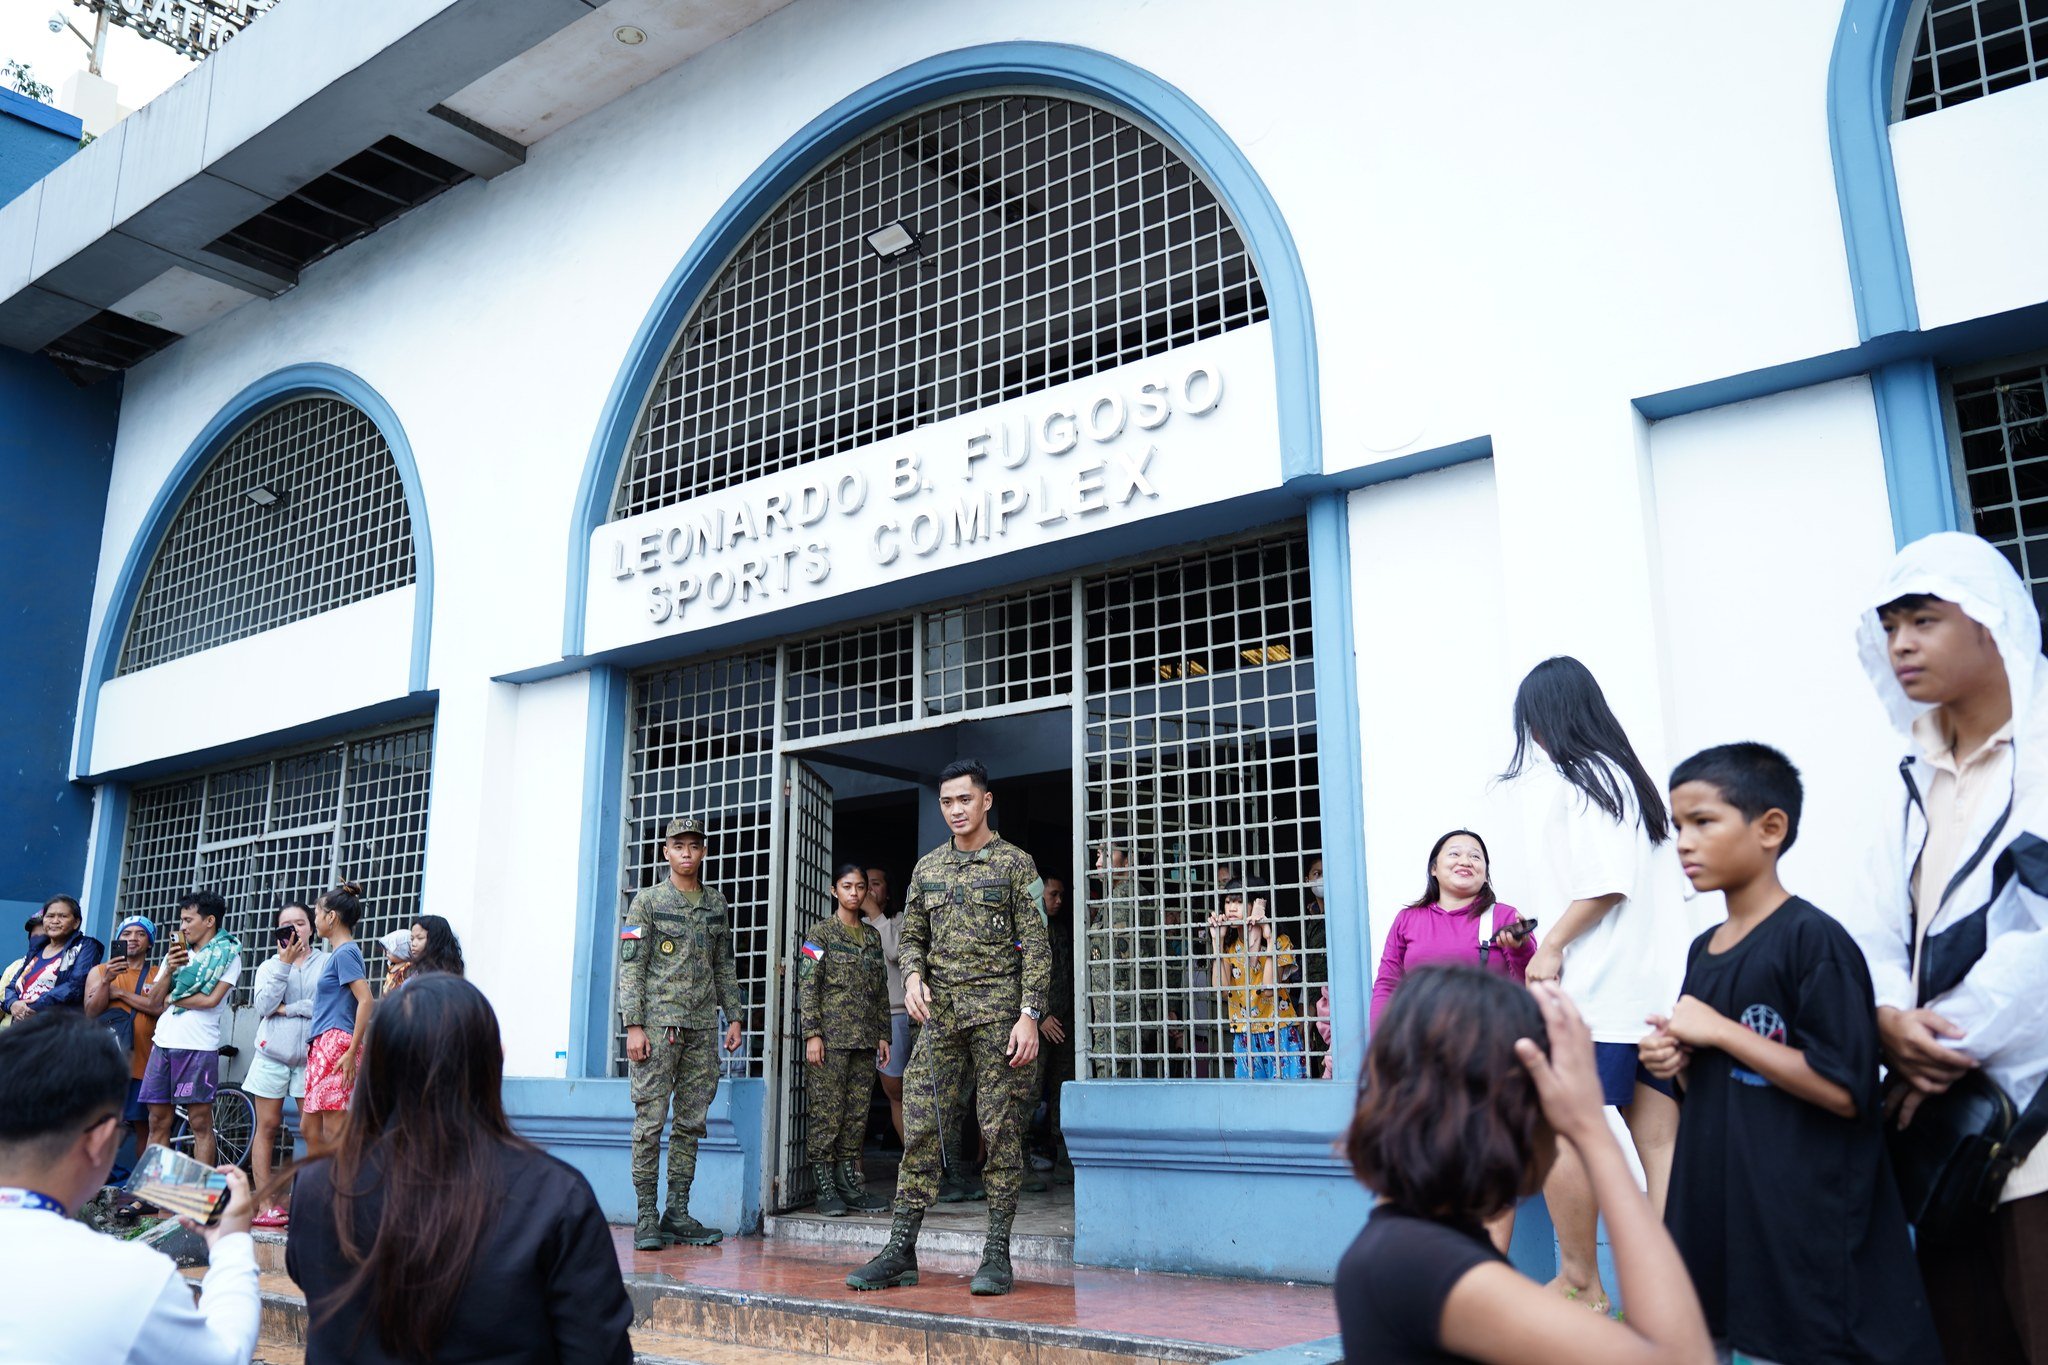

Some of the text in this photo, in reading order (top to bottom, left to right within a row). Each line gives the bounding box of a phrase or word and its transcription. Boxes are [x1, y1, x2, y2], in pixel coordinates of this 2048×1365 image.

[611, 361, 1224, 580] LEONARDO B. FUGOSO
[648, 445, 1159, 623] SPORTS COMPLEX
